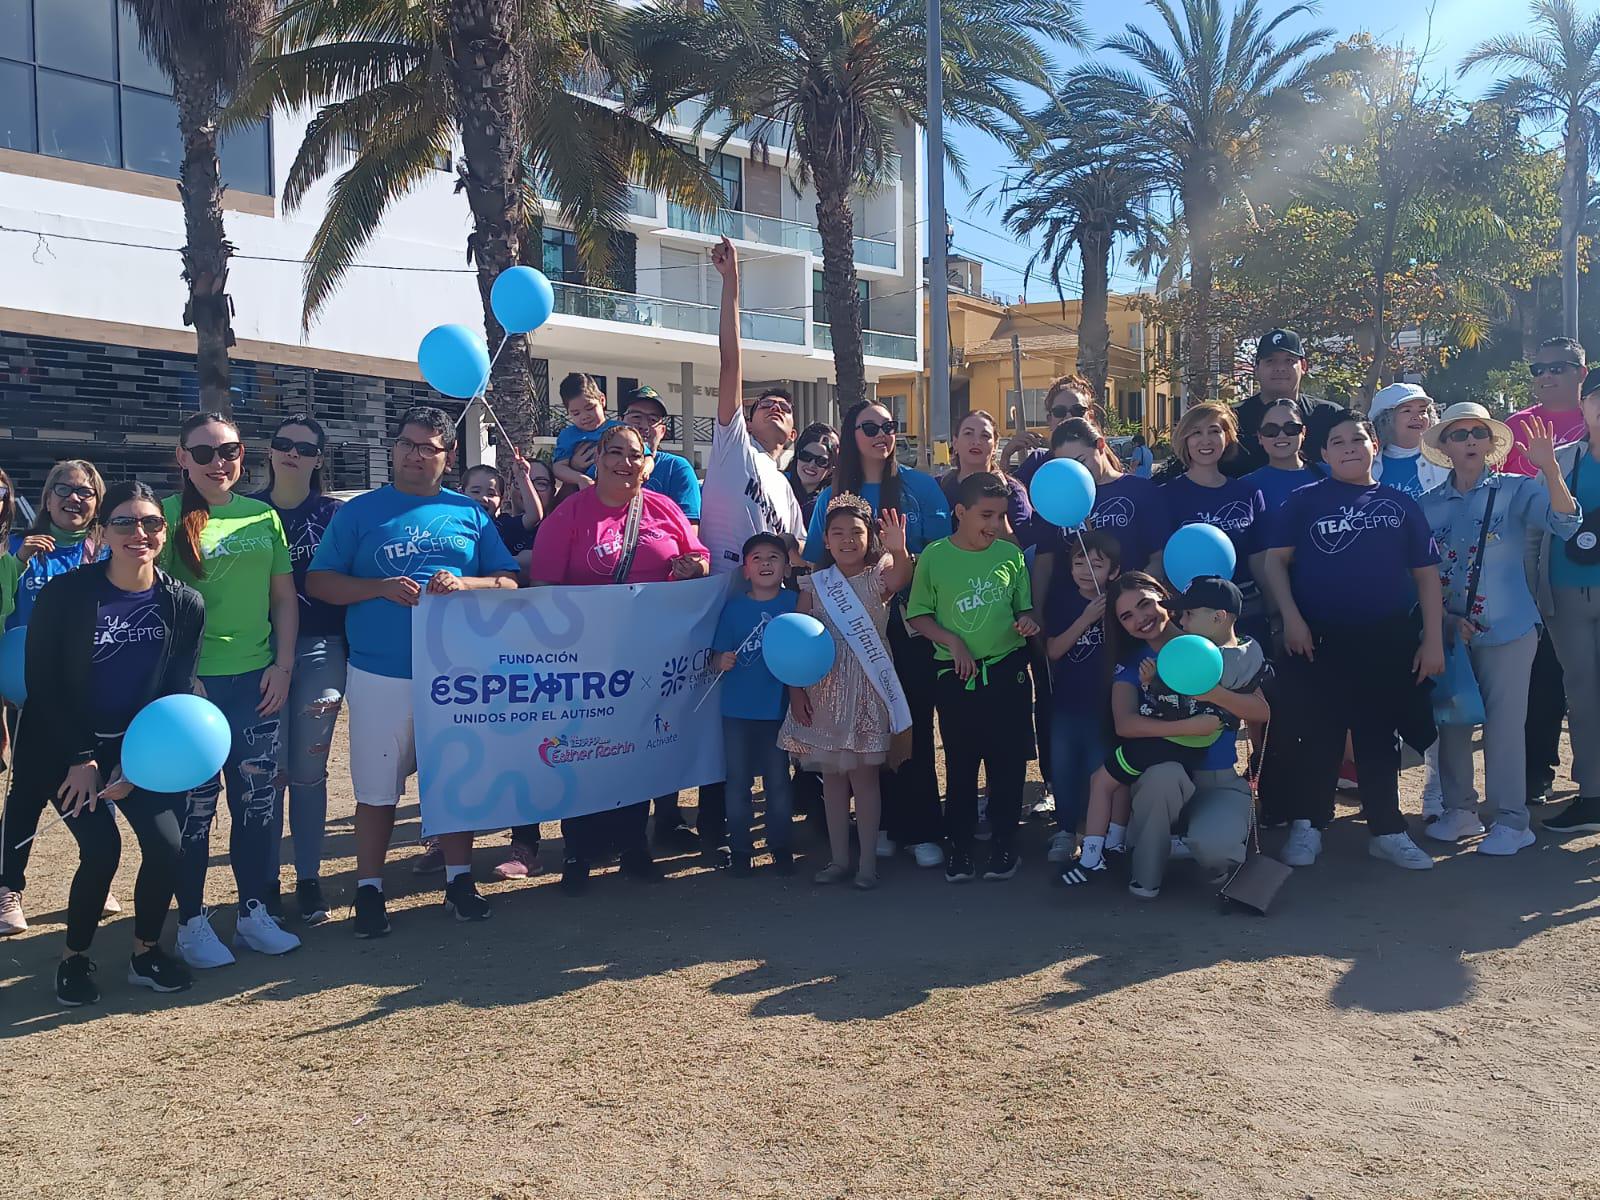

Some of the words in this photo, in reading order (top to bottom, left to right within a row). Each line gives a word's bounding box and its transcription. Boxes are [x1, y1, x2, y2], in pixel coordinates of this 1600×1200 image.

[1339, 506, 1366, 521] Yo
[404, 525, 431, 542] Yo
[968, 576, 993, 595] Yo
[104, 615, 131, 633] Yo
[827, 581, 853, 614] Reina
[846, 616, 888, 664] Infantil
[93, 626, 165, 645] EACEPTO
[499, 651, 578, 665] FUNDACIÓN
[453, 711, 506, 724] UNIDOS
[510, 711, 538, 723] POR
[541, 709, 557, 722] EL
[560, 706, 615, 720] AUTISMO
